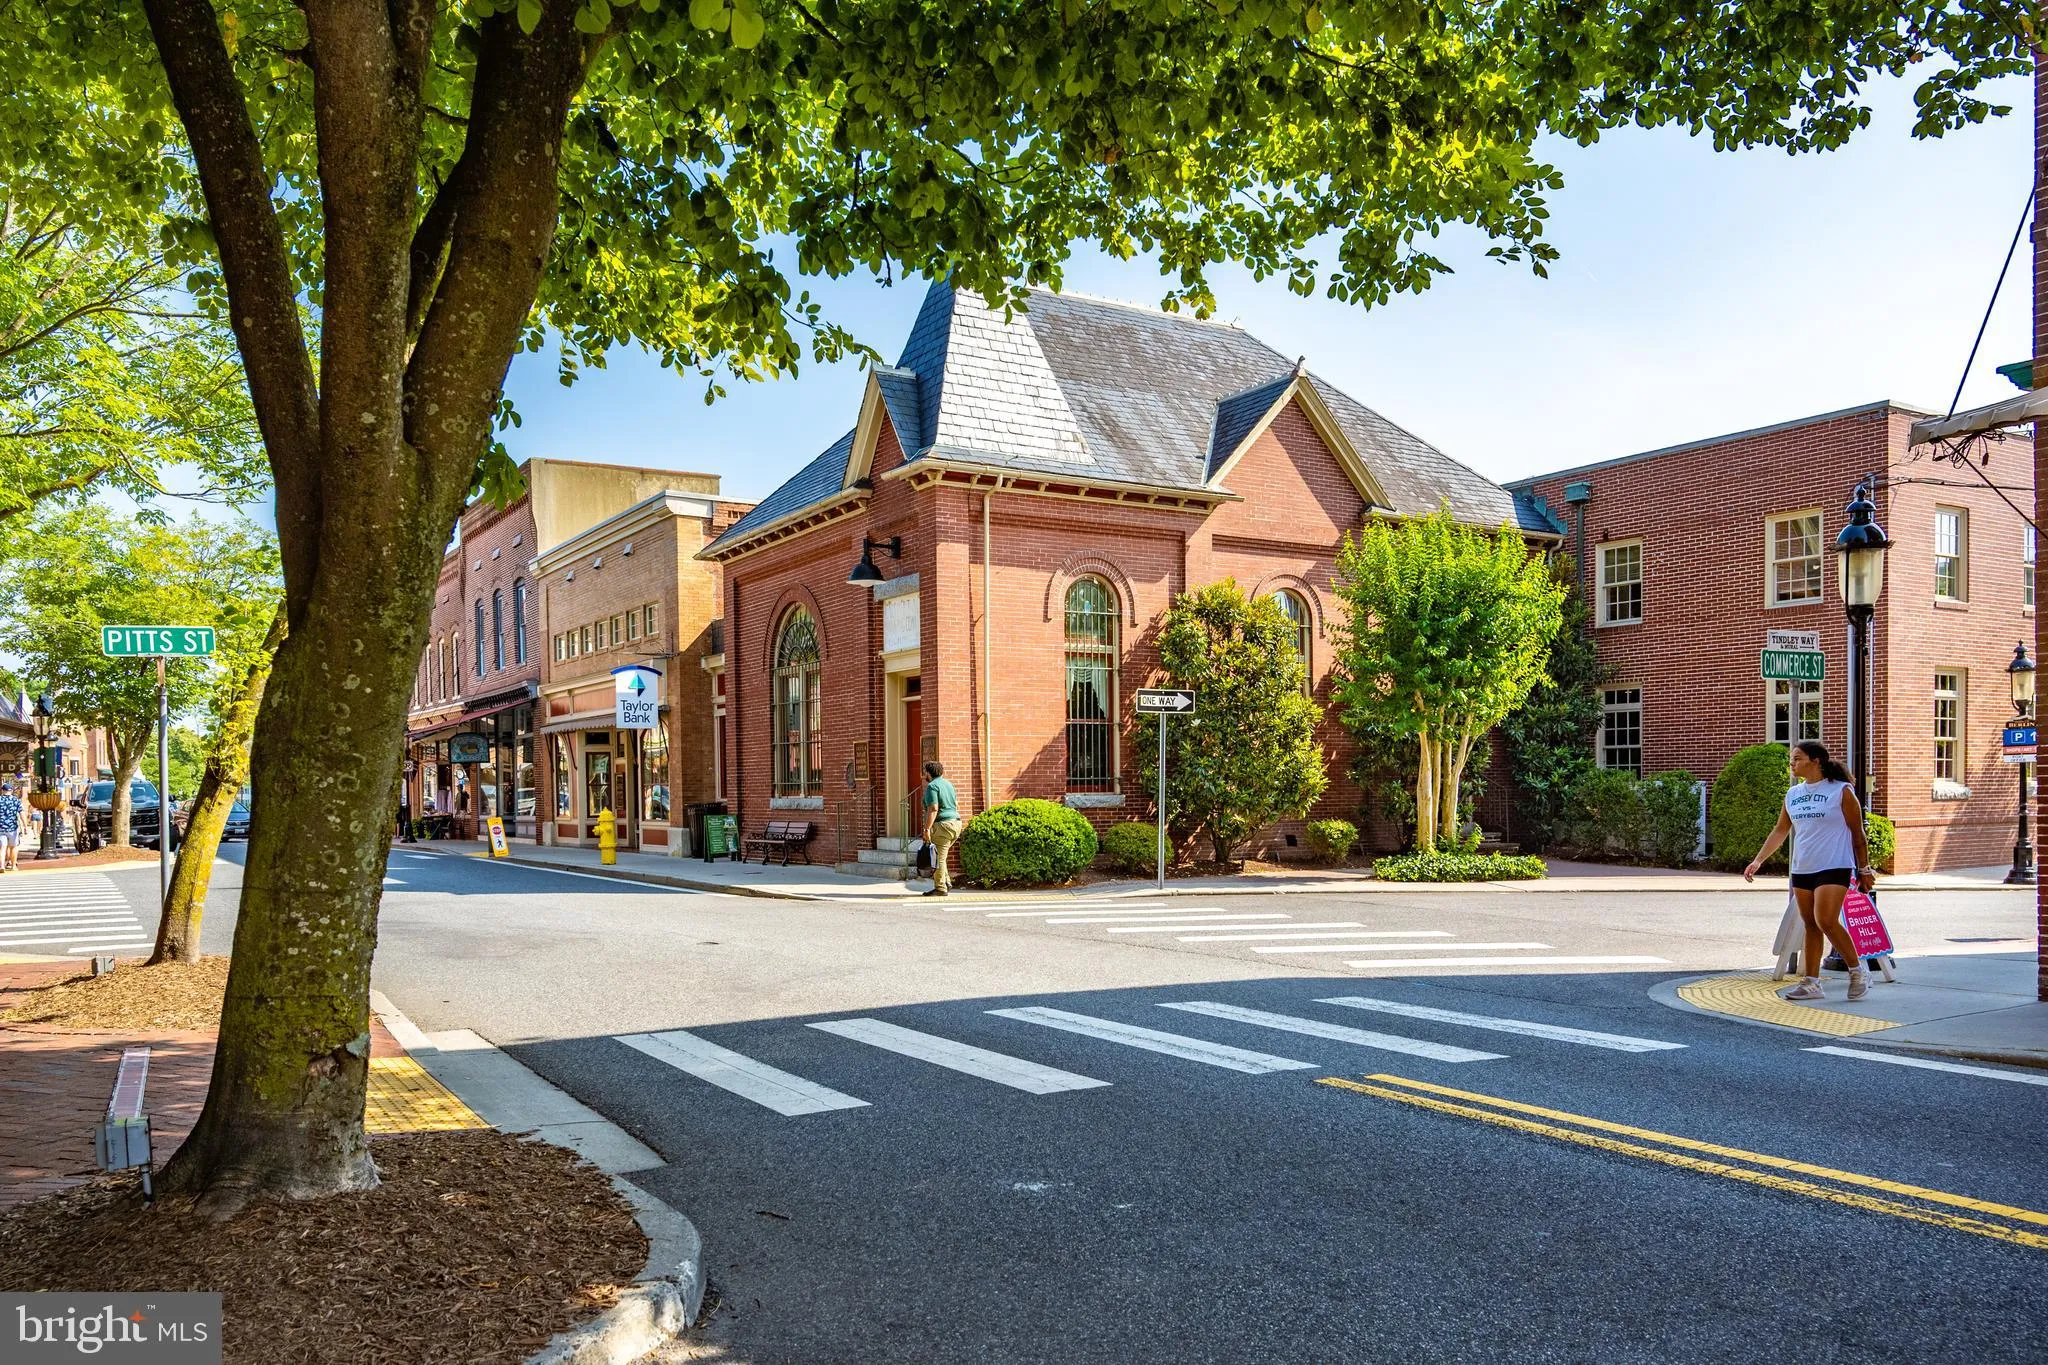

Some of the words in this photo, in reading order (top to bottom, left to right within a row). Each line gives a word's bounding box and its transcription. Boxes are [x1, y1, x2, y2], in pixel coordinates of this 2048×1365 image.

[107, 630, 173, 652] PITTS
[183, 630, 210, 652] ST
[1772, 635, 1800, 645] TINDLEY
[1800, 636, 1815, 645] WAY
[1764, 652, 1810, 677] COMMERCE
[1812, 655, 1822, 677] ST
[620, 699, 654, 714] Taylor
[1142, 696, 1156, 705] ONE
[1158, 696, 1176, 706] WAY
[623, 711, 651, 723] Bank
[1813, 794, 1828, 803] CITY
[1848, 914, 1878, 927] BRUDER
[1858, 927, 1877, 937] HILL
